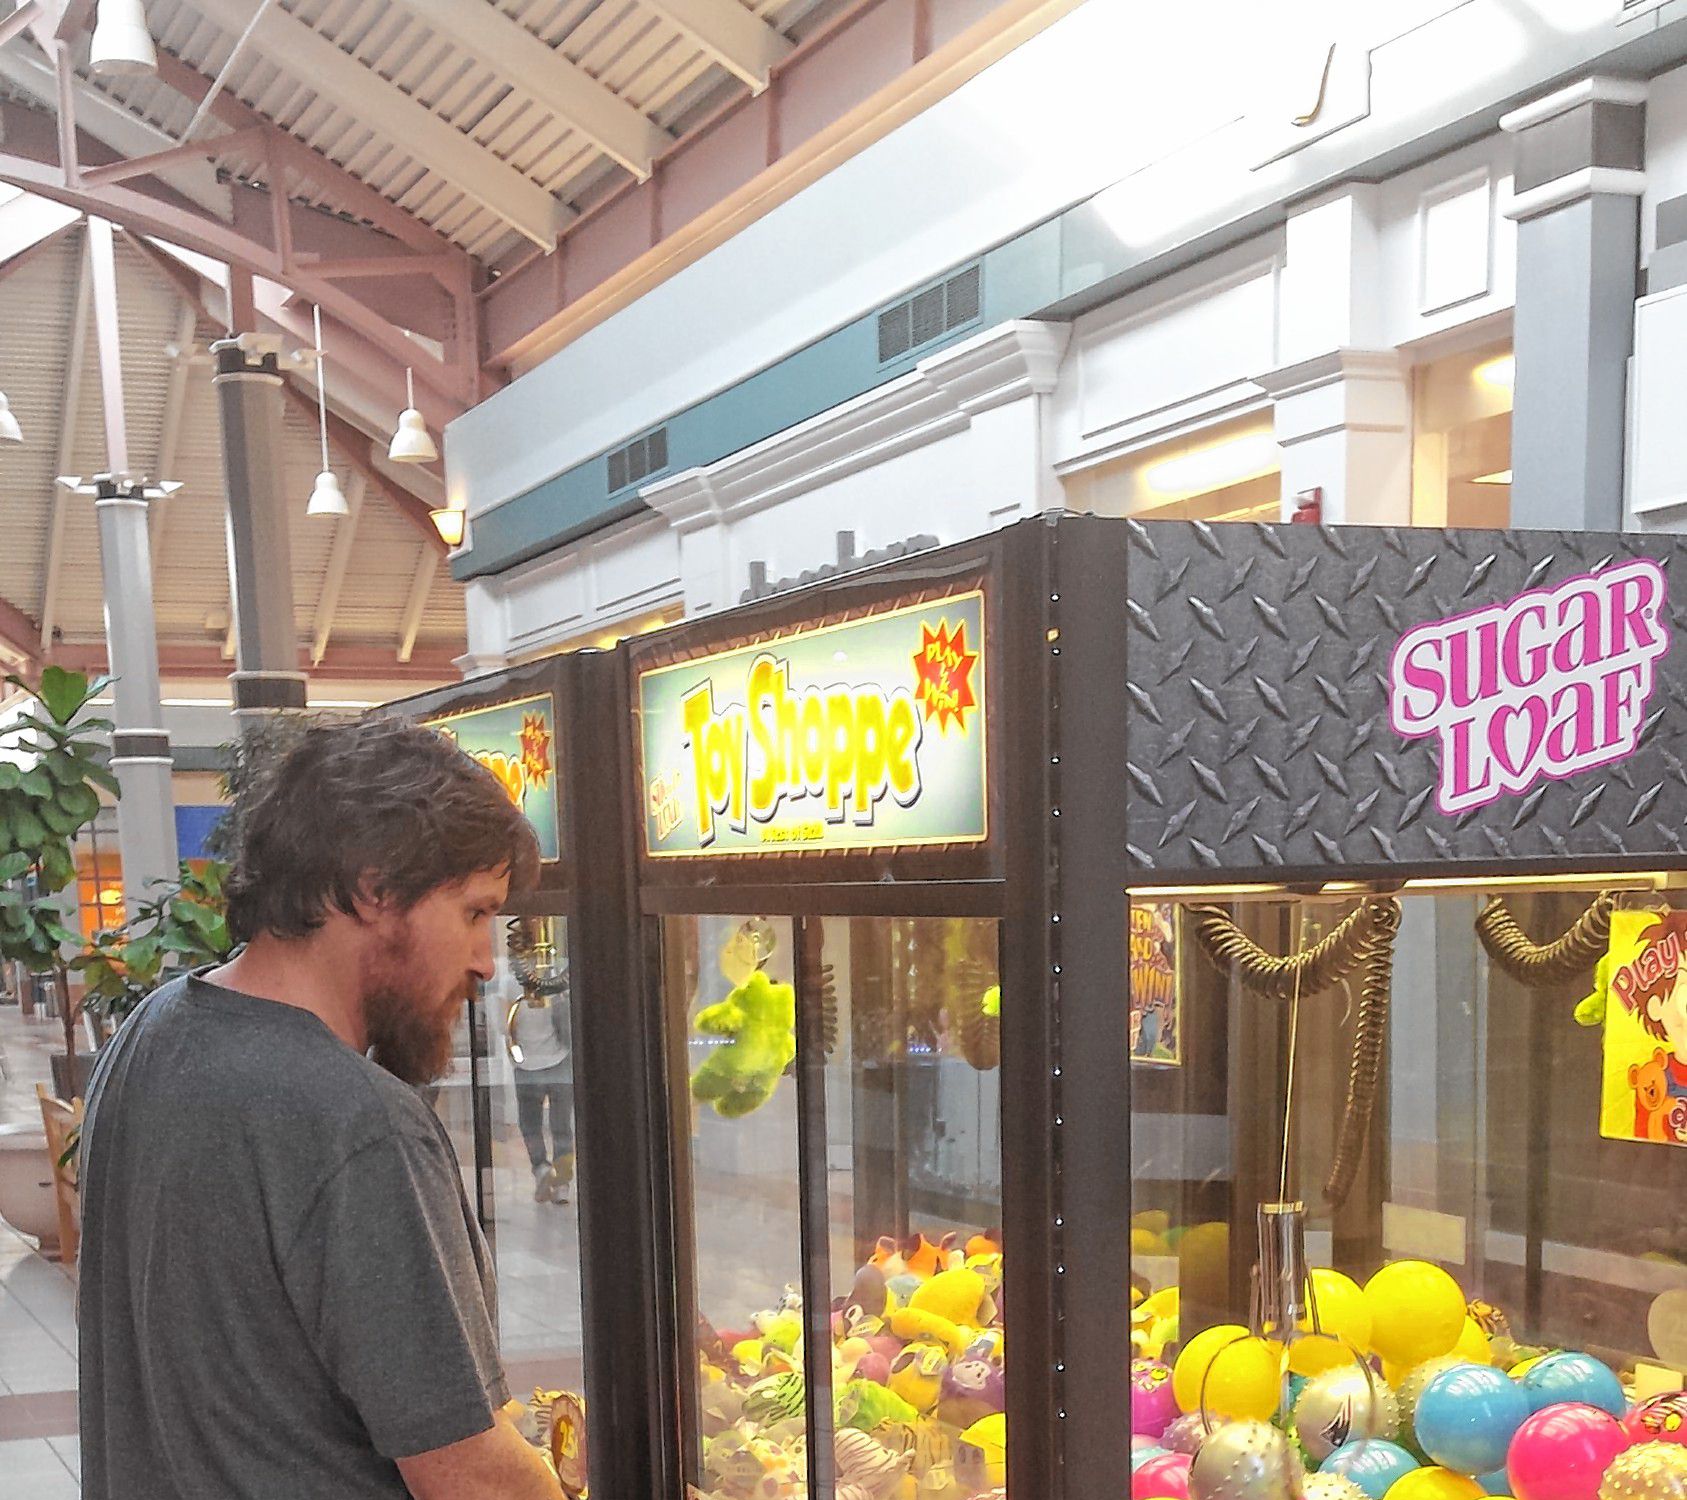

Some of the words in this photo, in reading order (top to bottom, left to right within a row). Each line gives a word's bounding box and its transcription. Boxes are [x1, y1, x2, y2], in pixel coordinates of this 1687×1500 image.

[682, 675, 749, 847] Toy
[746, 652, 922, 826] Shoppe
[1611, 930, 1681, 1016] Play
